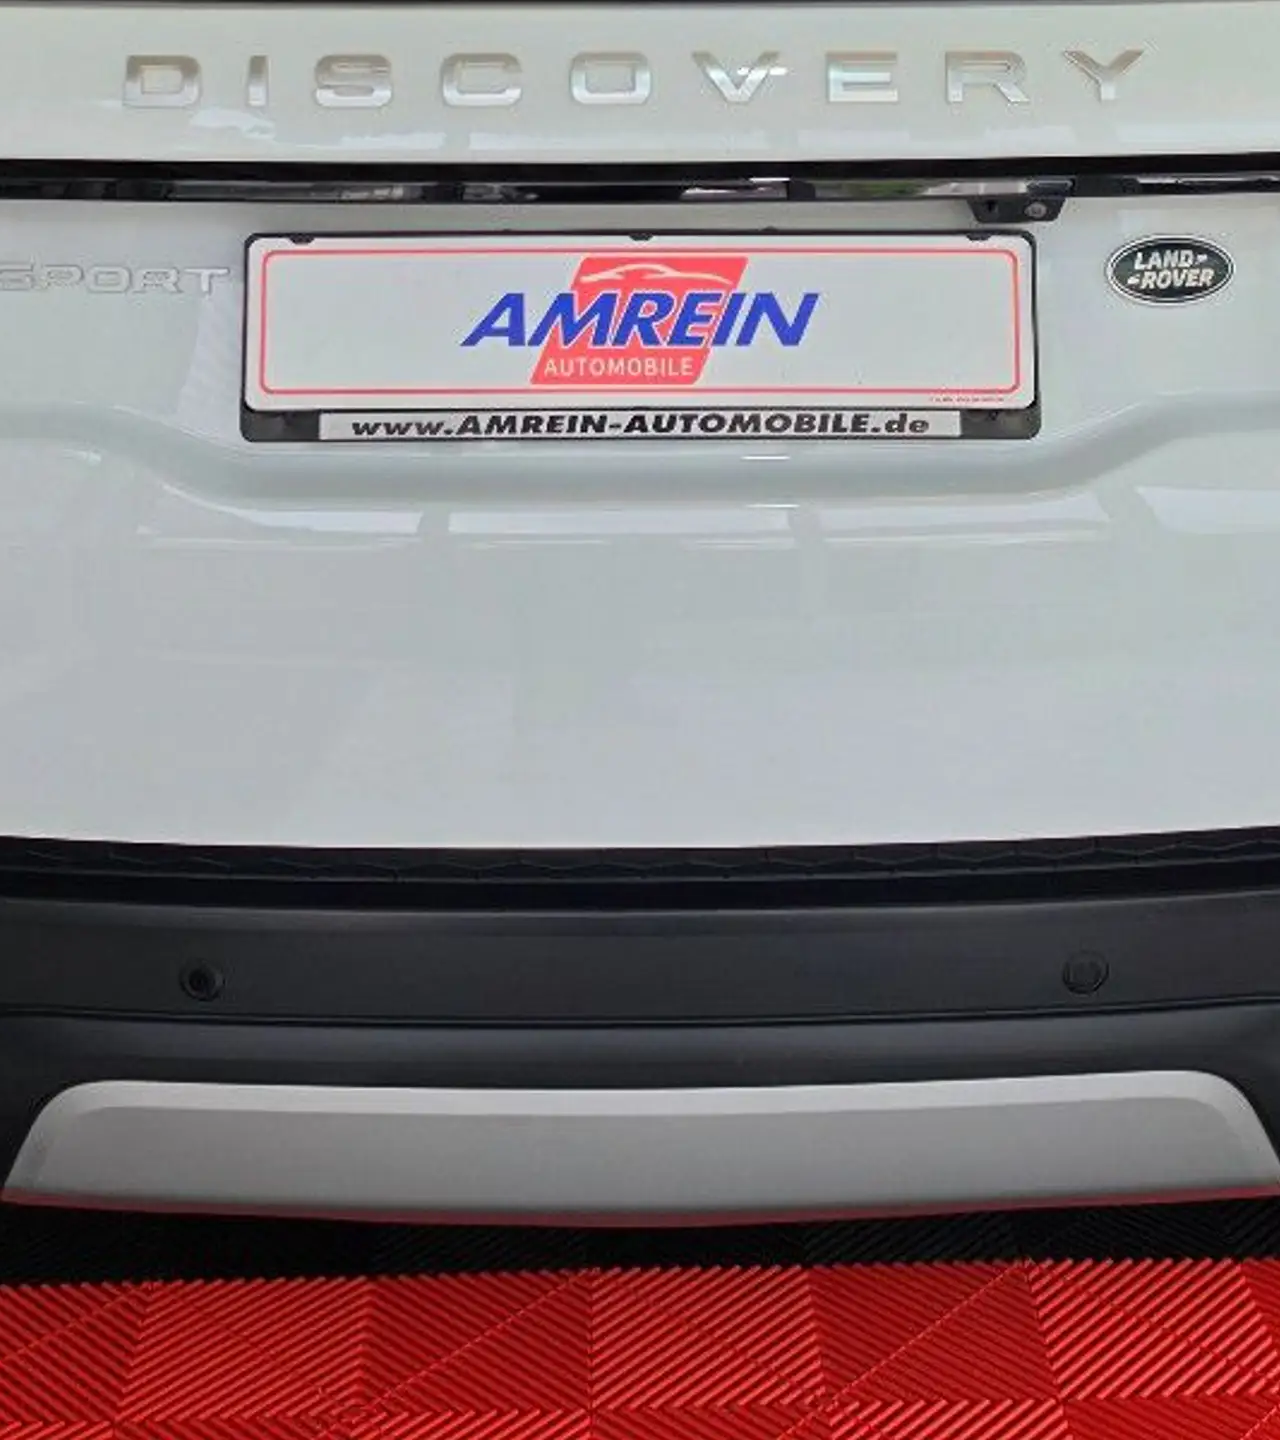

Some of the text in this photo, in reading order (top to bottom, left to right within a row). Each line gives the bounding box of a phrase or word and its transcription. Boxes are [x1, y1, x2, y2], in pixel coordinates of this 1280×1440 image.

[123, 50, 1146, 108] DISCOVERY
[1134, 249, 1196, 271] LAND
[1140, 268, 1215, 290] ROVER
[460, 292, 820, 348] AMREIN
[543, 357, 695, 377] AUTOMOBILE
[351, 411, 930, 436] www.AMREIN-AUTOMOBILE.de
